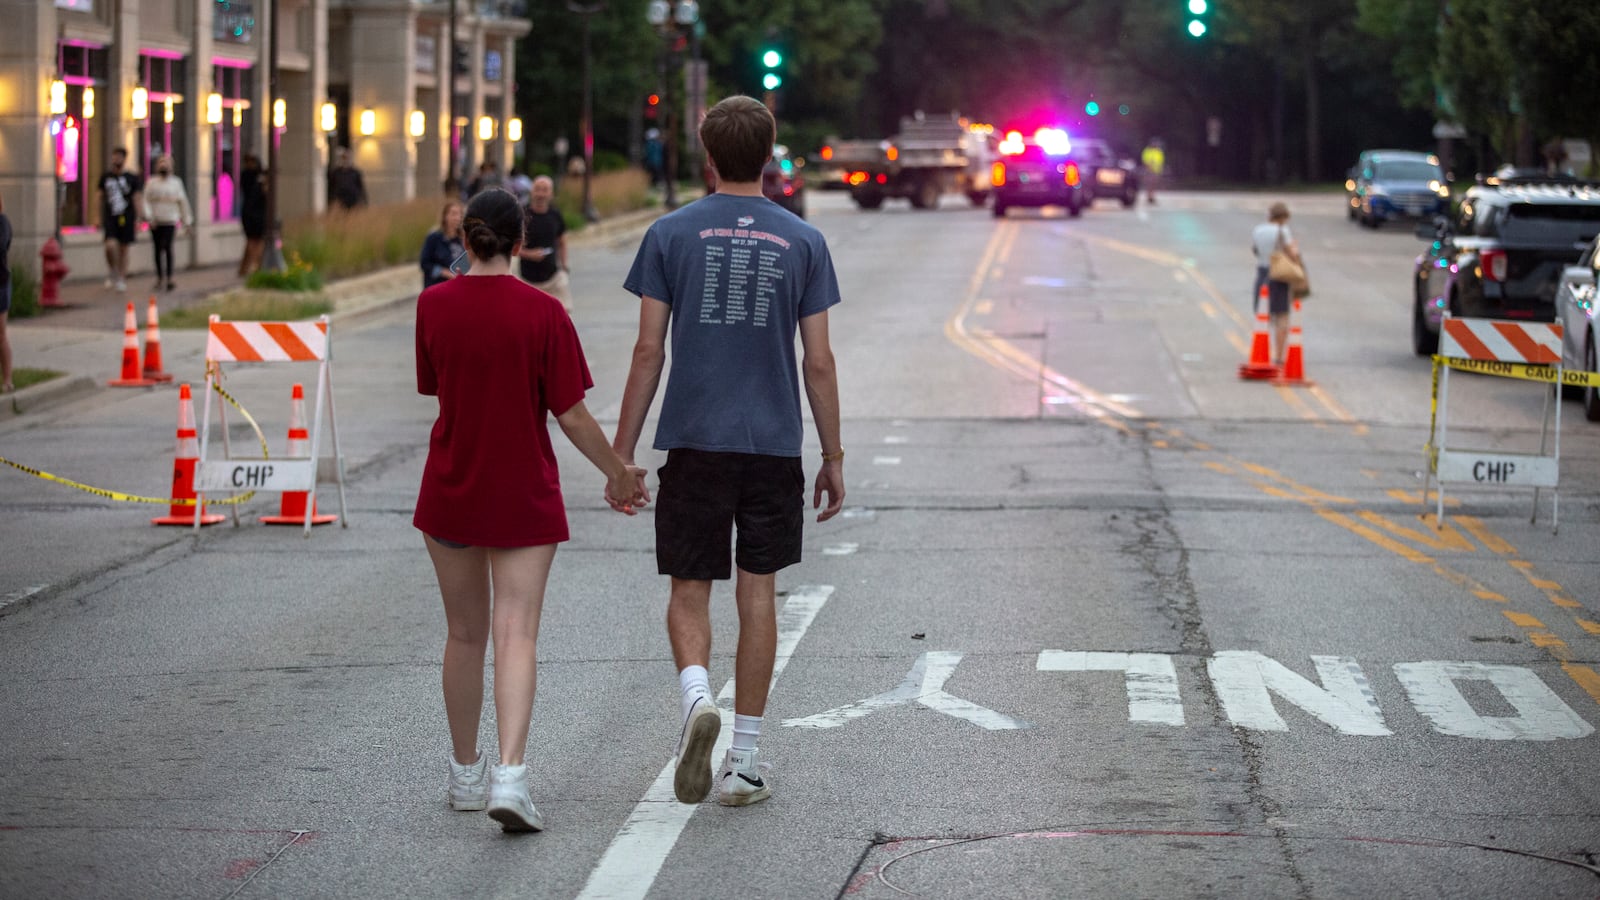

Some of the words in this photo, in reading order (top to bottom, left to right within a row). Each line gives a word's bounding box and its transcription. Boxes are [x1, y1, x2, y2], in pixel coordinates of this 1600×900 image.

[232, 465, 274, 487] CHP
[1473, 460, 1516, 483] CHP
[781, 649, 1595, 741] ONLY
